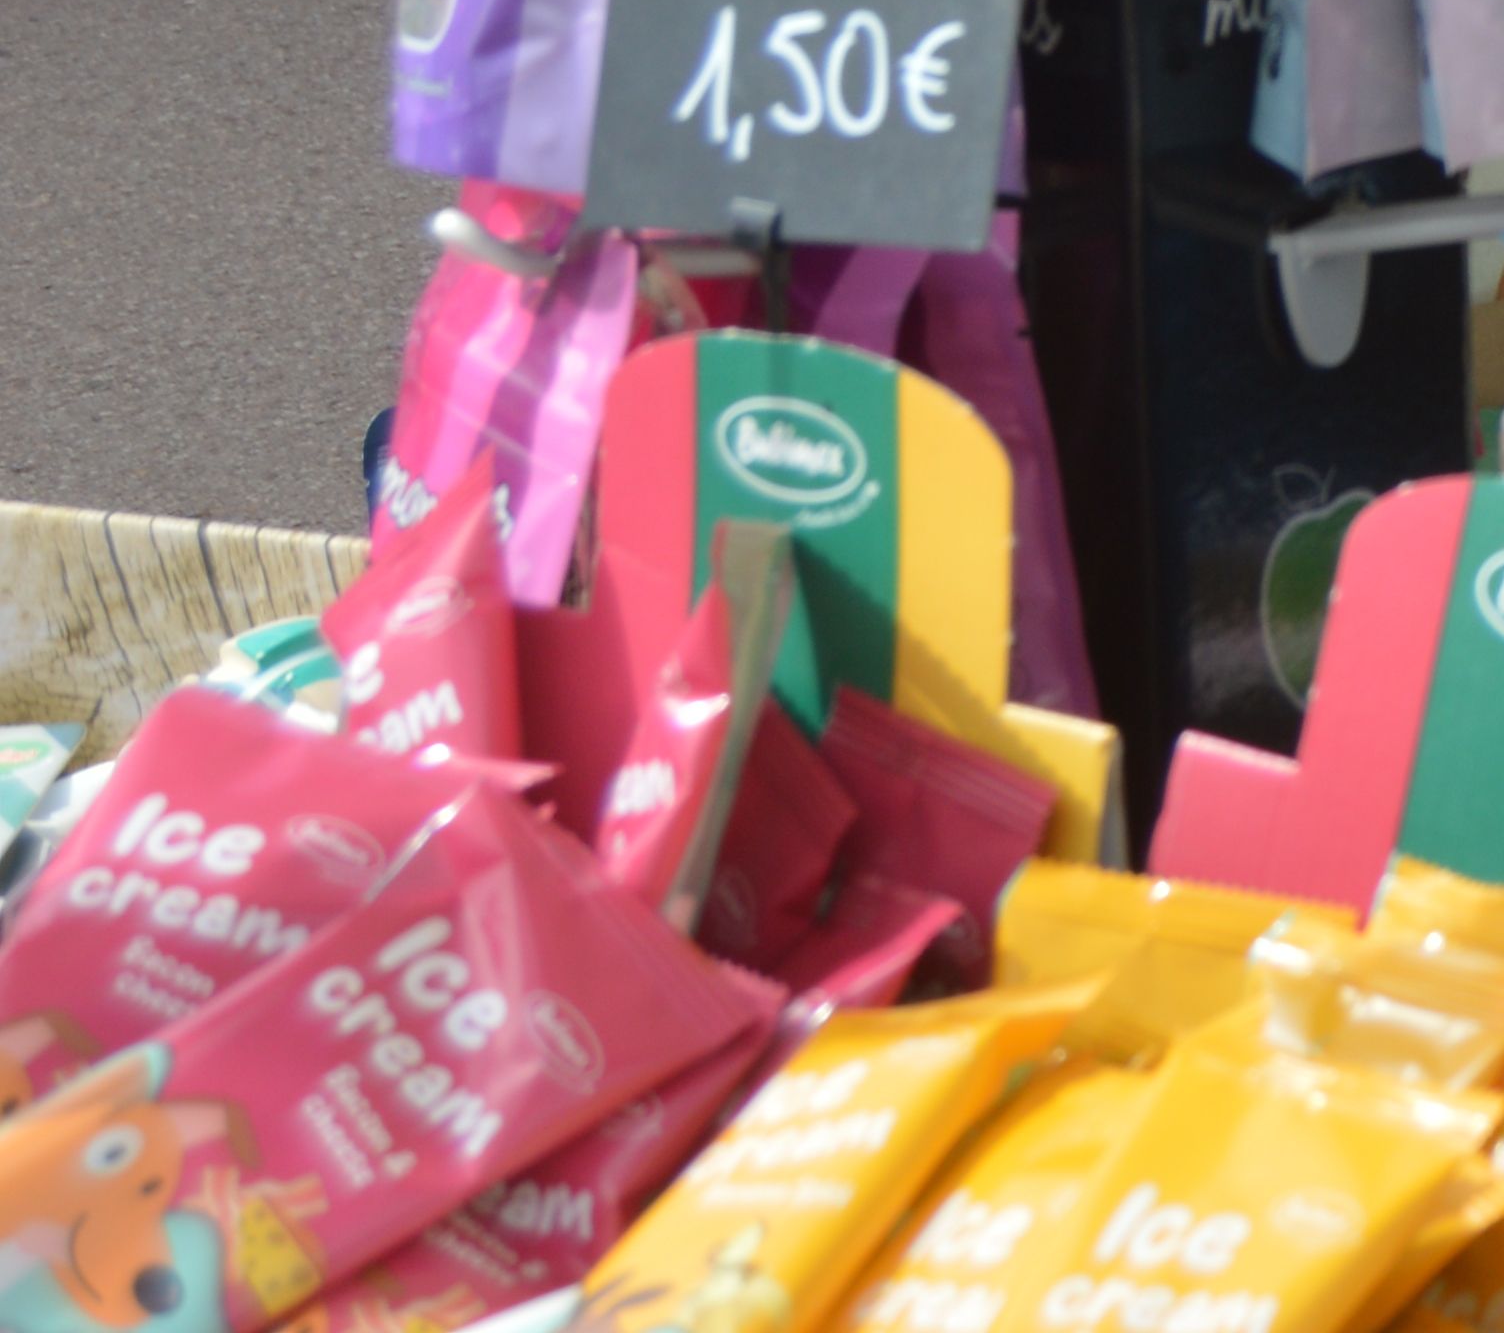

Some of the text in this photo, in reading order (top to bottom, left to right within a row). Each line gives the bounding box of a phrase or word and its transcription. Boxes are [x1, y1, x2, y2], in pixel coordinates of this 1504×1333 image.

[670, 4, 968, 164] 1,50€
[111, 792, 267, 878] Ice
[66, 865, 312, 957] cream
[374, 913, 510, 1055] Ice
[307, 964, 504, 1158] cream
[1094, 1180, 1253, 1277] Ice
